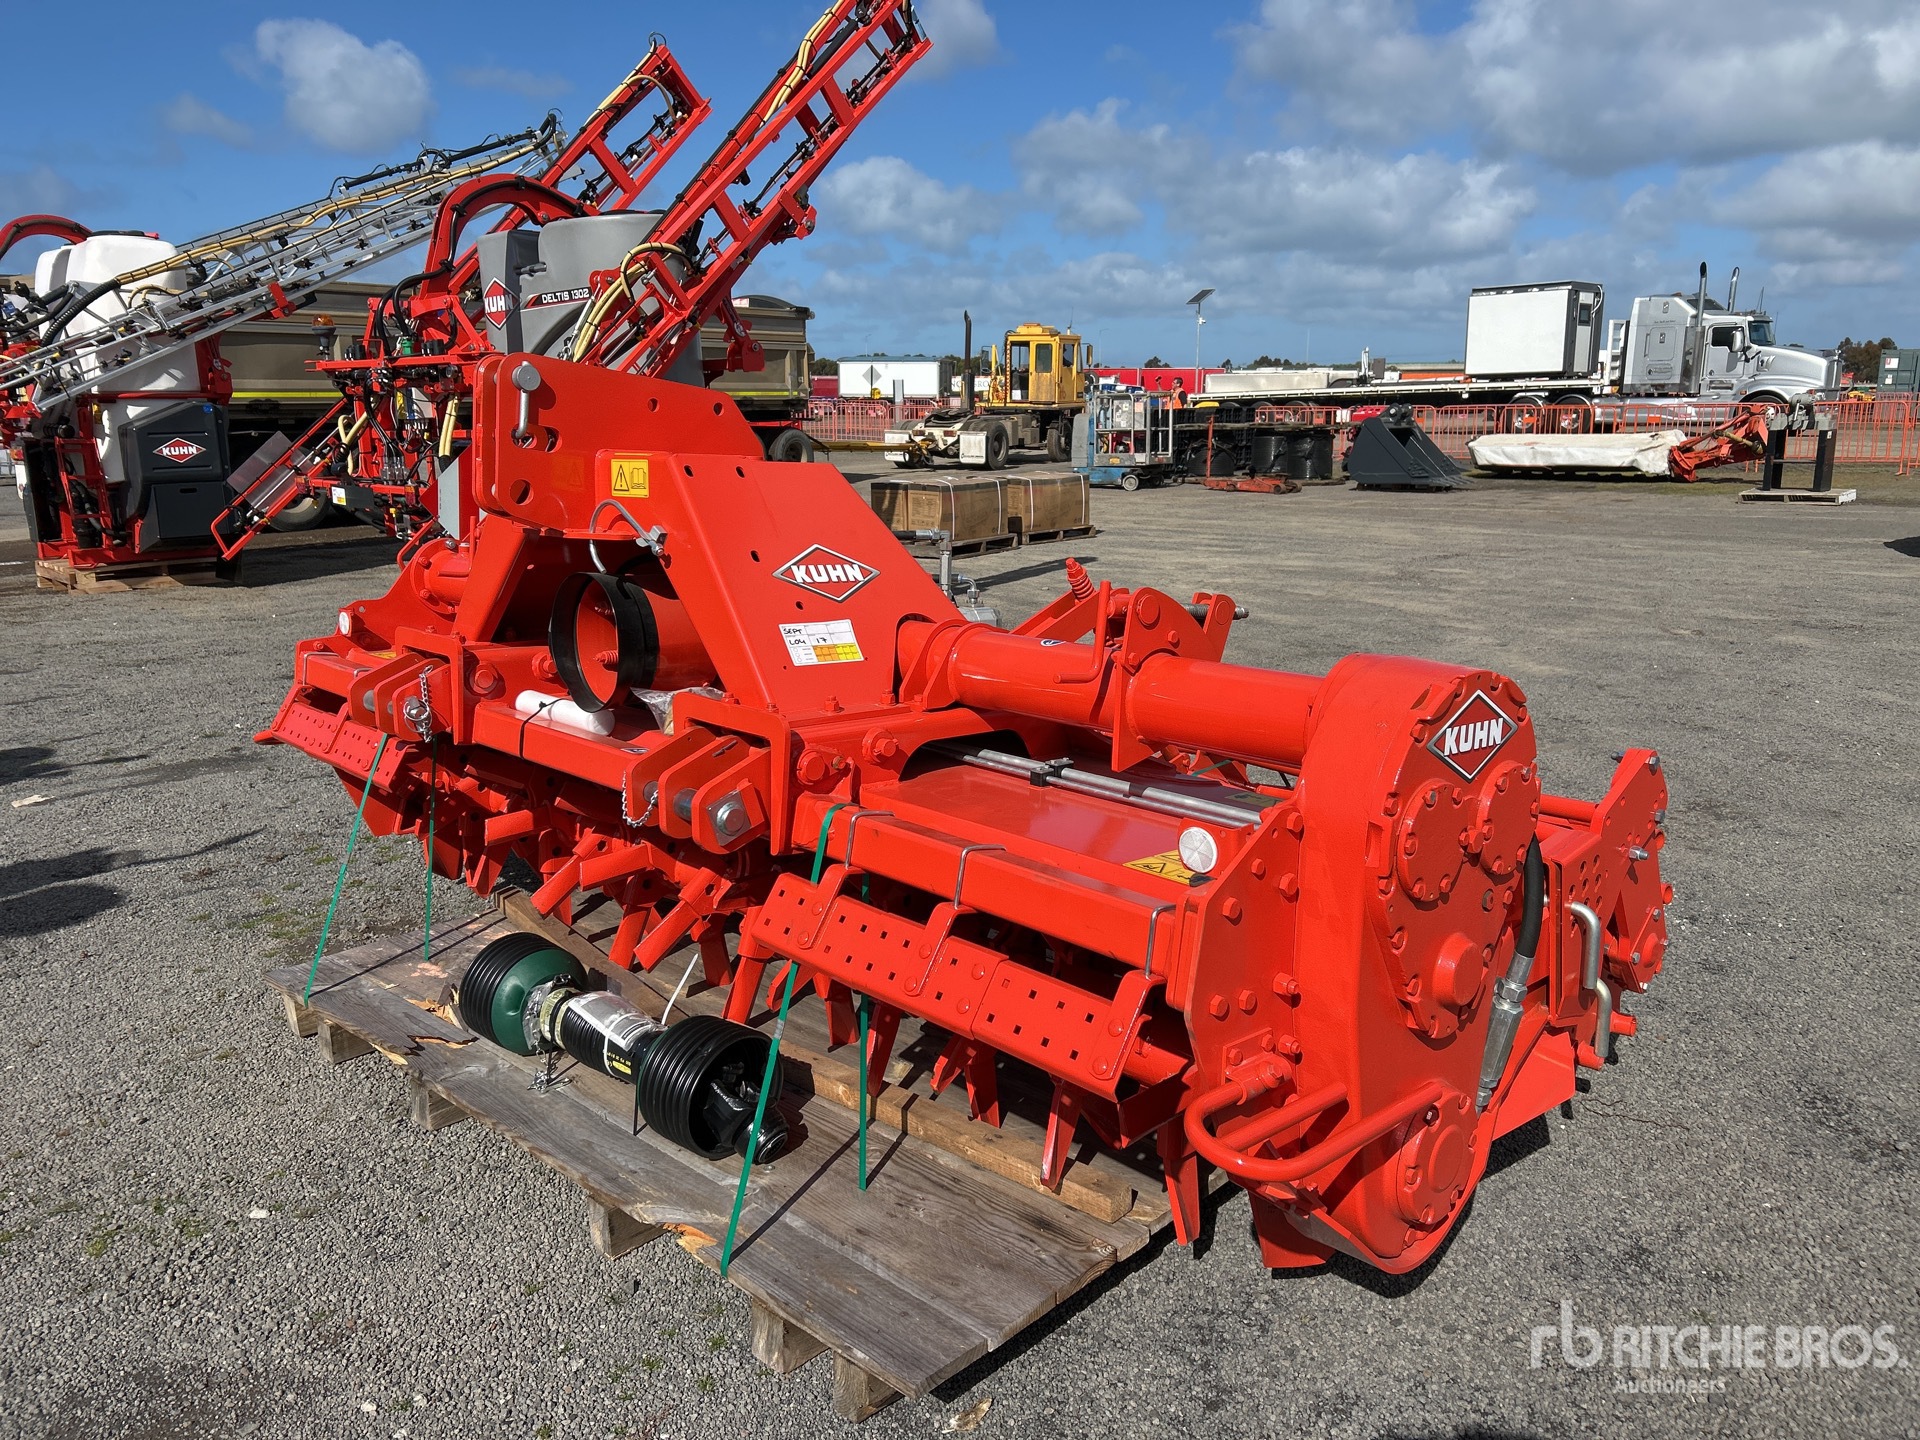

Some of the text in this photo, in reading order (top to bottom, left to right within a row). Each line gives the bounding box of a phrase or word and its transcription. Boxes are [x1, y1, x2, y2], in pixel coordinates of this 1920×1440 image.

[484, 293, 514, 314] KUHN
[541, 288, 590, 304] DELTIS 1302
[162, 446, 198, 456] KUHN
[790, 563, 865, 583] KUHN
[815, 636, 828, 644] 17
[1443, 717, 1504, 756] KUHN
